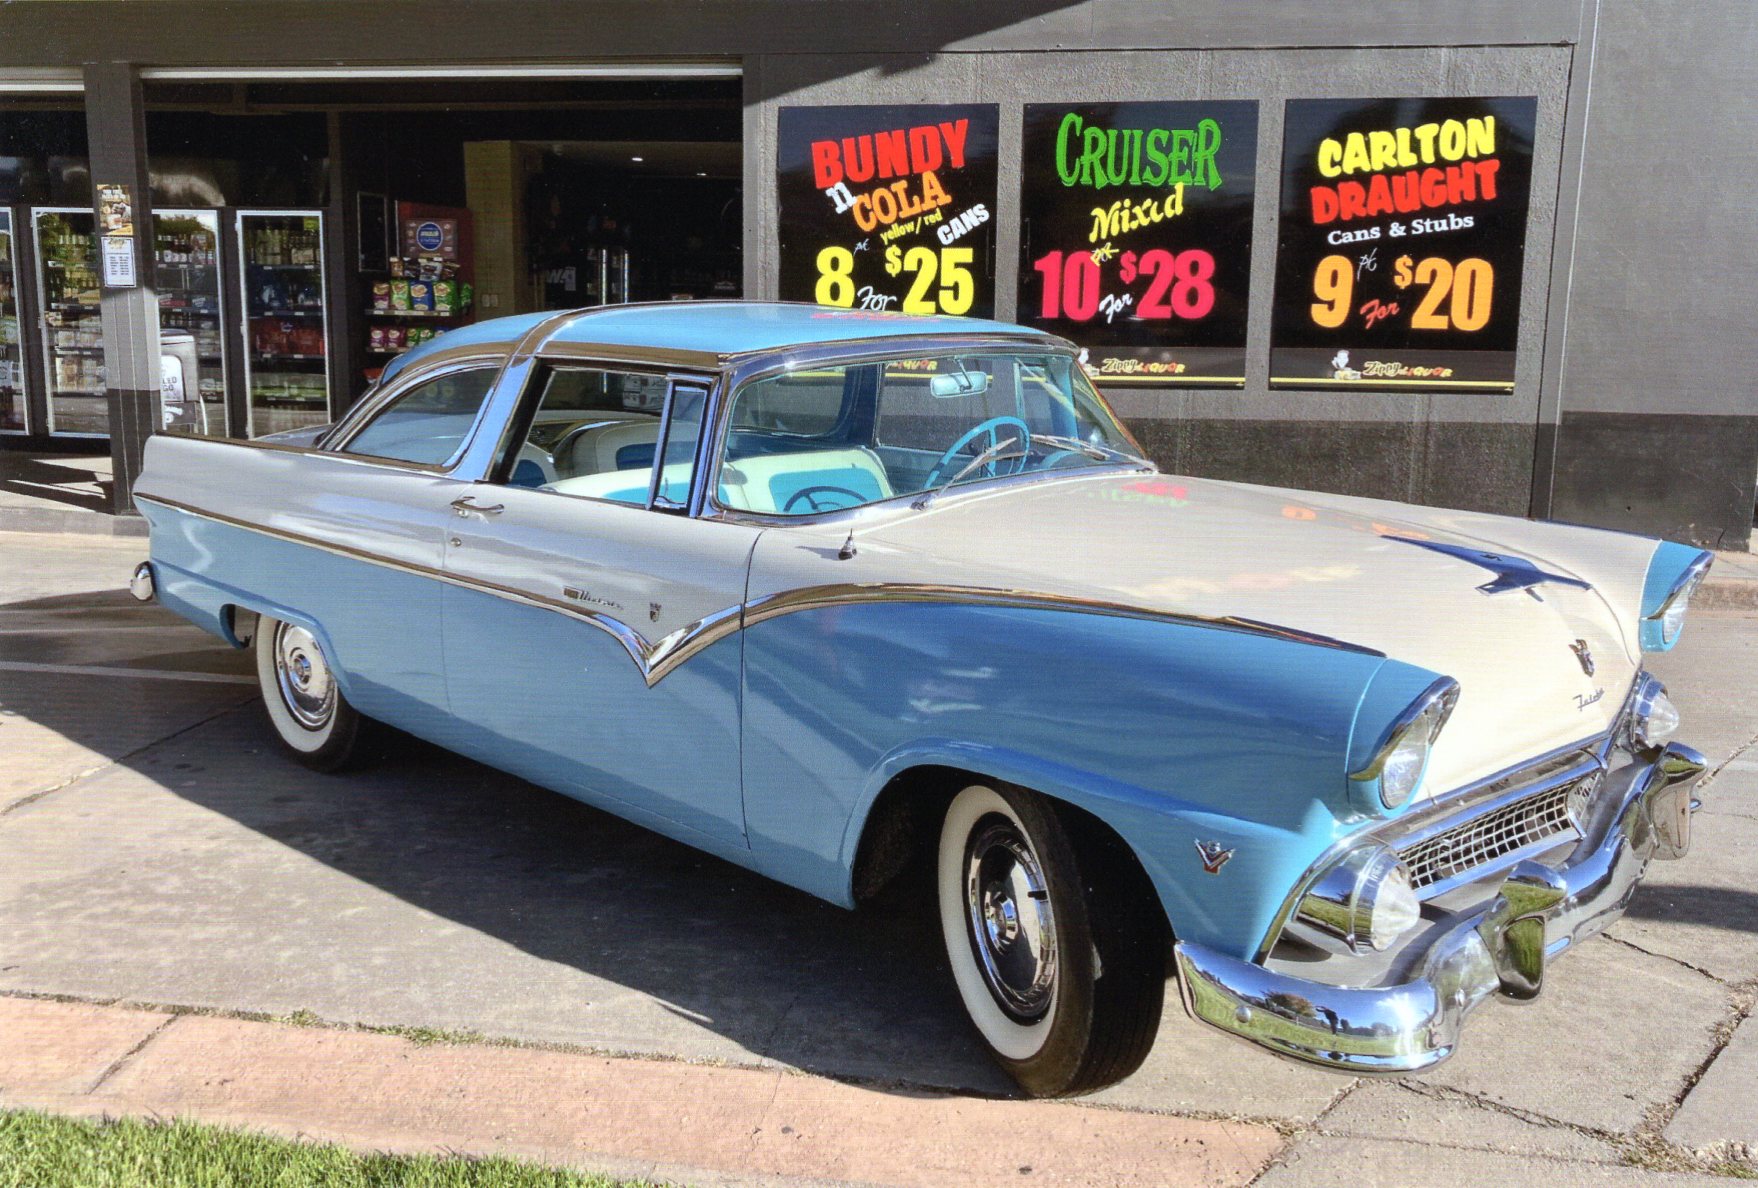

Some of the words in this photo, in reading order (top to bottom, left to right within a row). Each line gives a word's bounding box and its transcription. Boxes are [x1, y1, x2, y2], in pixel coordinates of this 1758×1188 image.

[811, 118, 968, 189] BUNDY
[1056, 112, 1222, 190] CRUISER
[1317, 116, 1496, 178] CARLTON
[852, 170, 952, 232] COLA
[1089, 181, 1184, 243] Mixed
[1310, 159, 1500, 225] DRAUGHT
[936, 203, 990, 245] CANS
[1327, 225, 1382, 246] Cans
[1388, 222, 1407, 238] &
[1411, 213, 1475, 236] Stubs
[815, 246, 855, 308] 8
[856, 285, 896, 312] For
[885, 244, 974, 315] $25
[1034, 250, 1101, 321] 10
[1099, 293, 1133, 324] For
[1119, 249, 1216, 319] $28
[1310, 254, 1353, 329] 9
[1359, 298, 1399, 330] For
[1393, 254, 1494, 332] $20
[1101, 358, 1137, 374] Zippy
[1135, 362, 1185, 374] LIQUOR
[1362, 361, 1401, 377] Zippy
